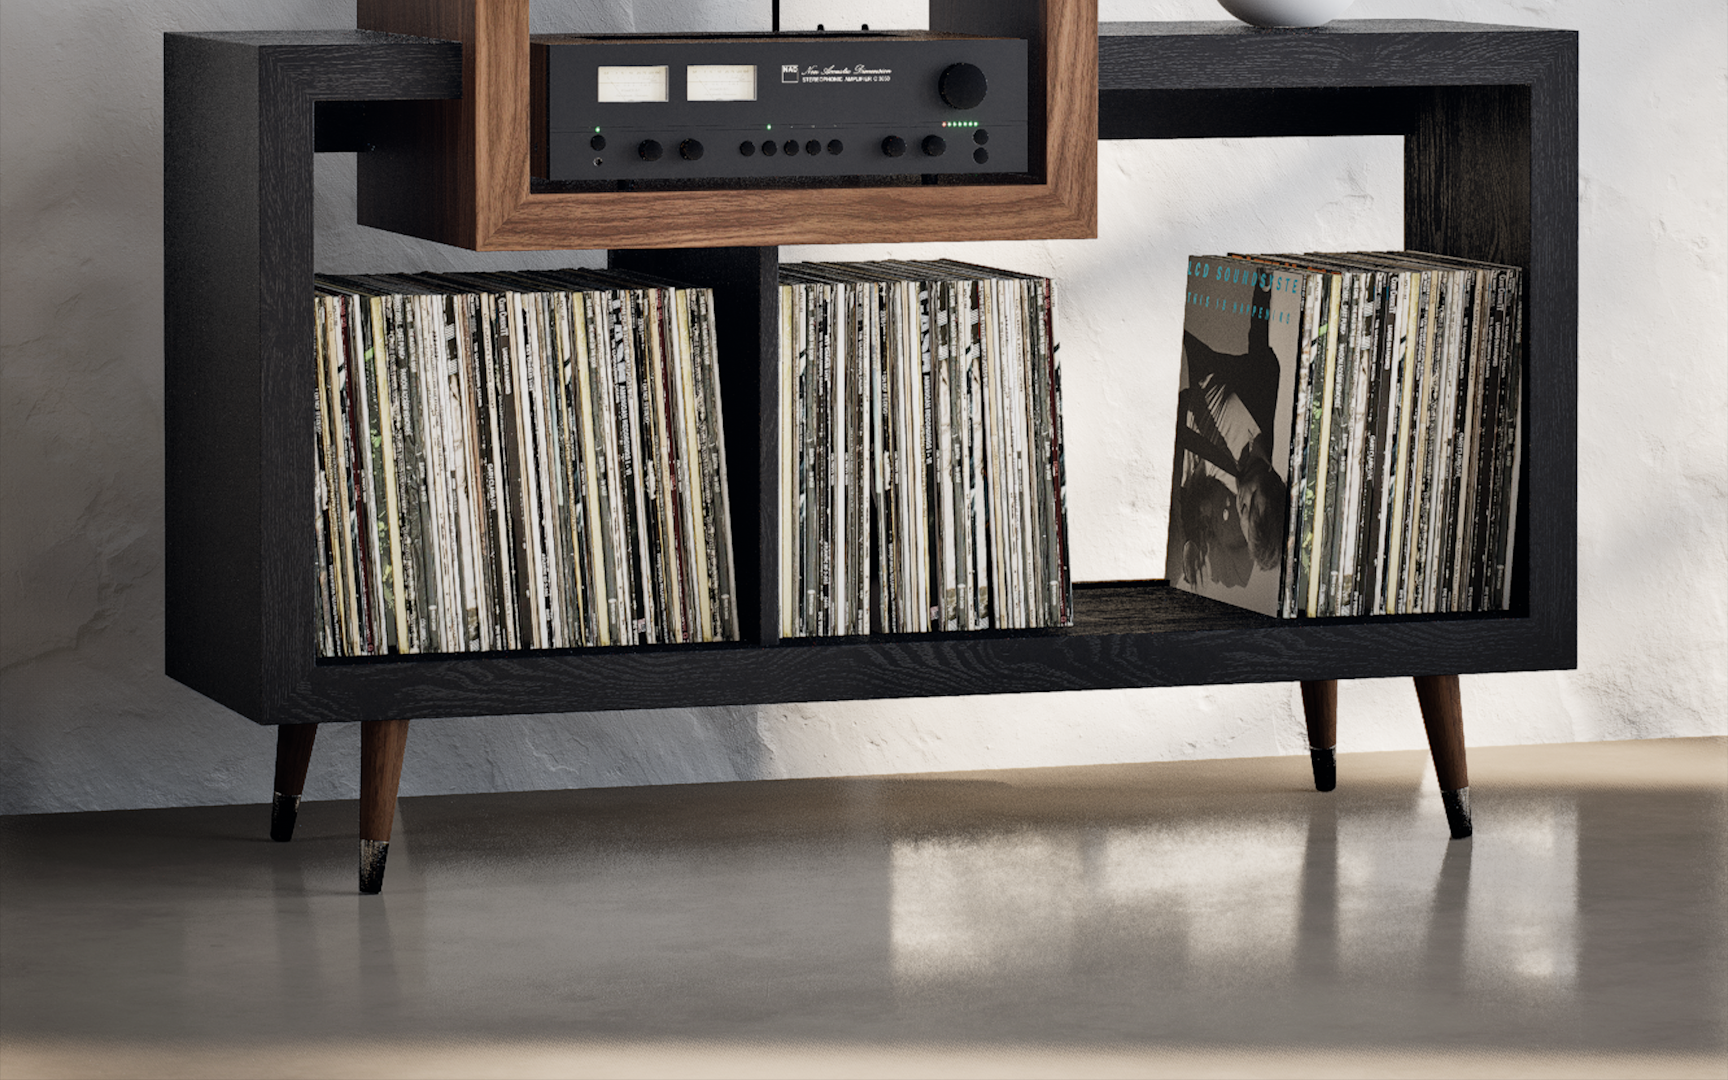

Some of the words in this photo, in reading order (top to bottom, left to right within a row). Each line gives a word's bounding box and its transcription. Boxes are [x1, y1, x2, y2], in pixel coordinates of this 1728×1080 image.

[1188, 260, 1210, 279] LCD
[1216, 265, 1302, 295] SOUNDSYSTE
[1187, 291, 1210, 308] THIS
[1216, 298, 1227, 311] IS
[1232, 301, 1290, 324] HAPPENING
